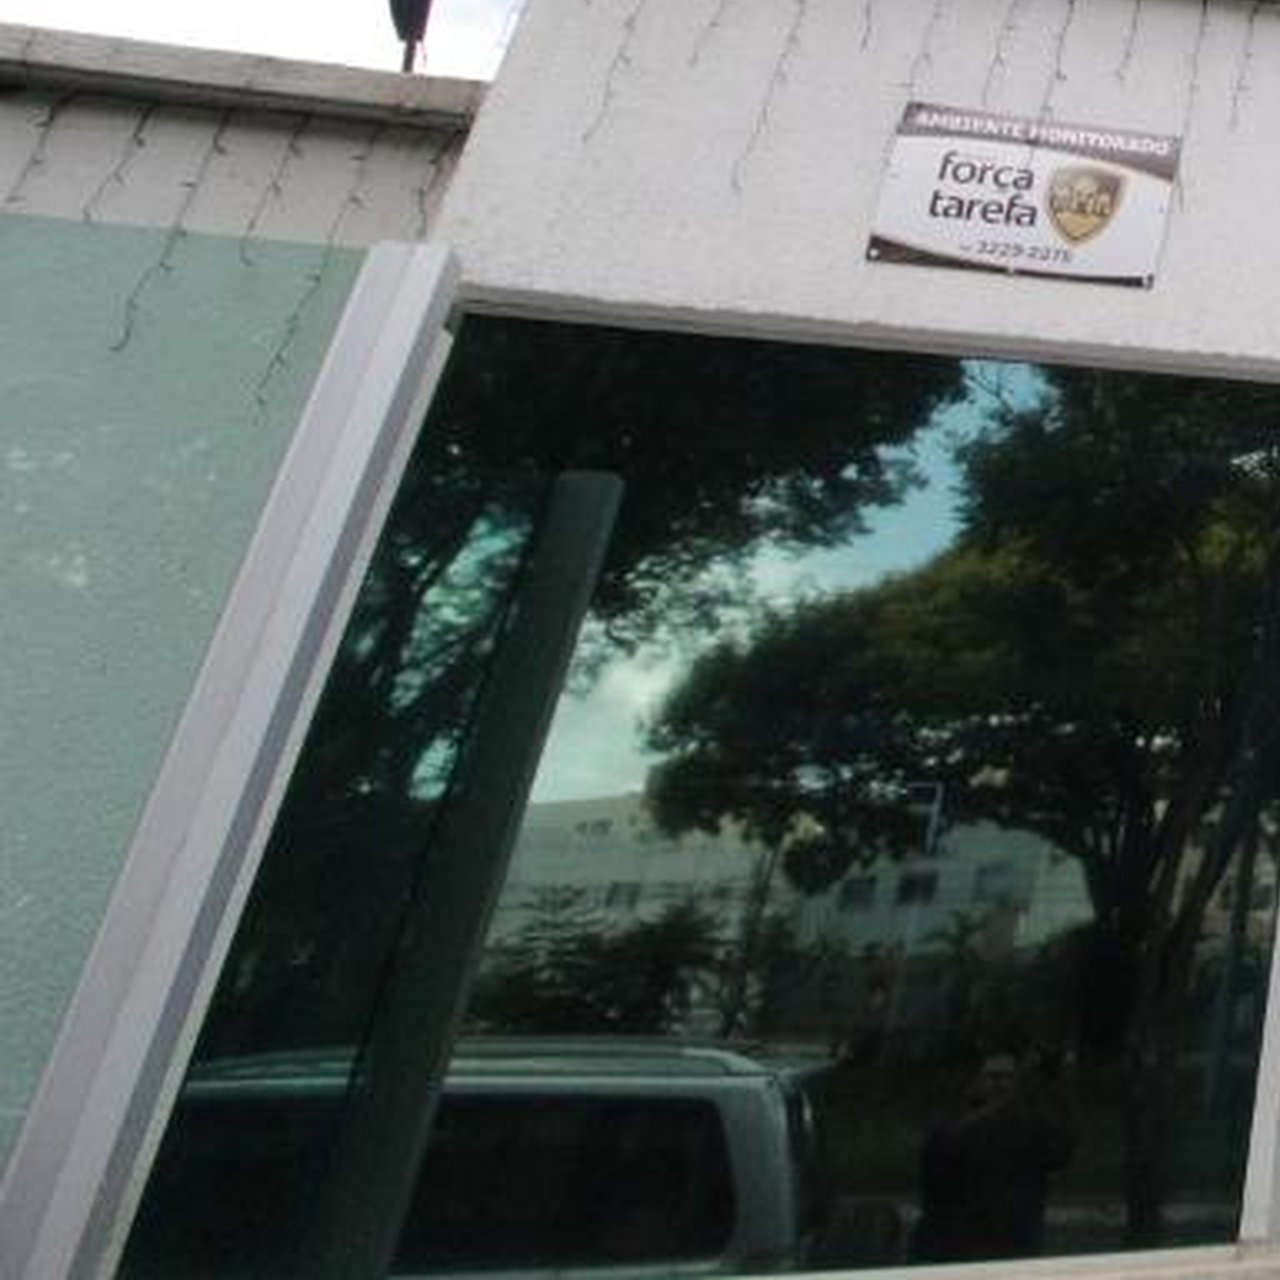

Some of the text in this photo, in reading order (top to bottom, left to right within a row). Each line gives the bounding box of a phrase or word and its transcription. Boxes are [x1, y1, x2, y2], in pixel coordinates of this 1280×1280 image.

[916, 109, 1171, 156] AMBIENTE MONITORADO
[937, 150, 1035, 192] força
[928, 190, 1038, 227] tarefa
